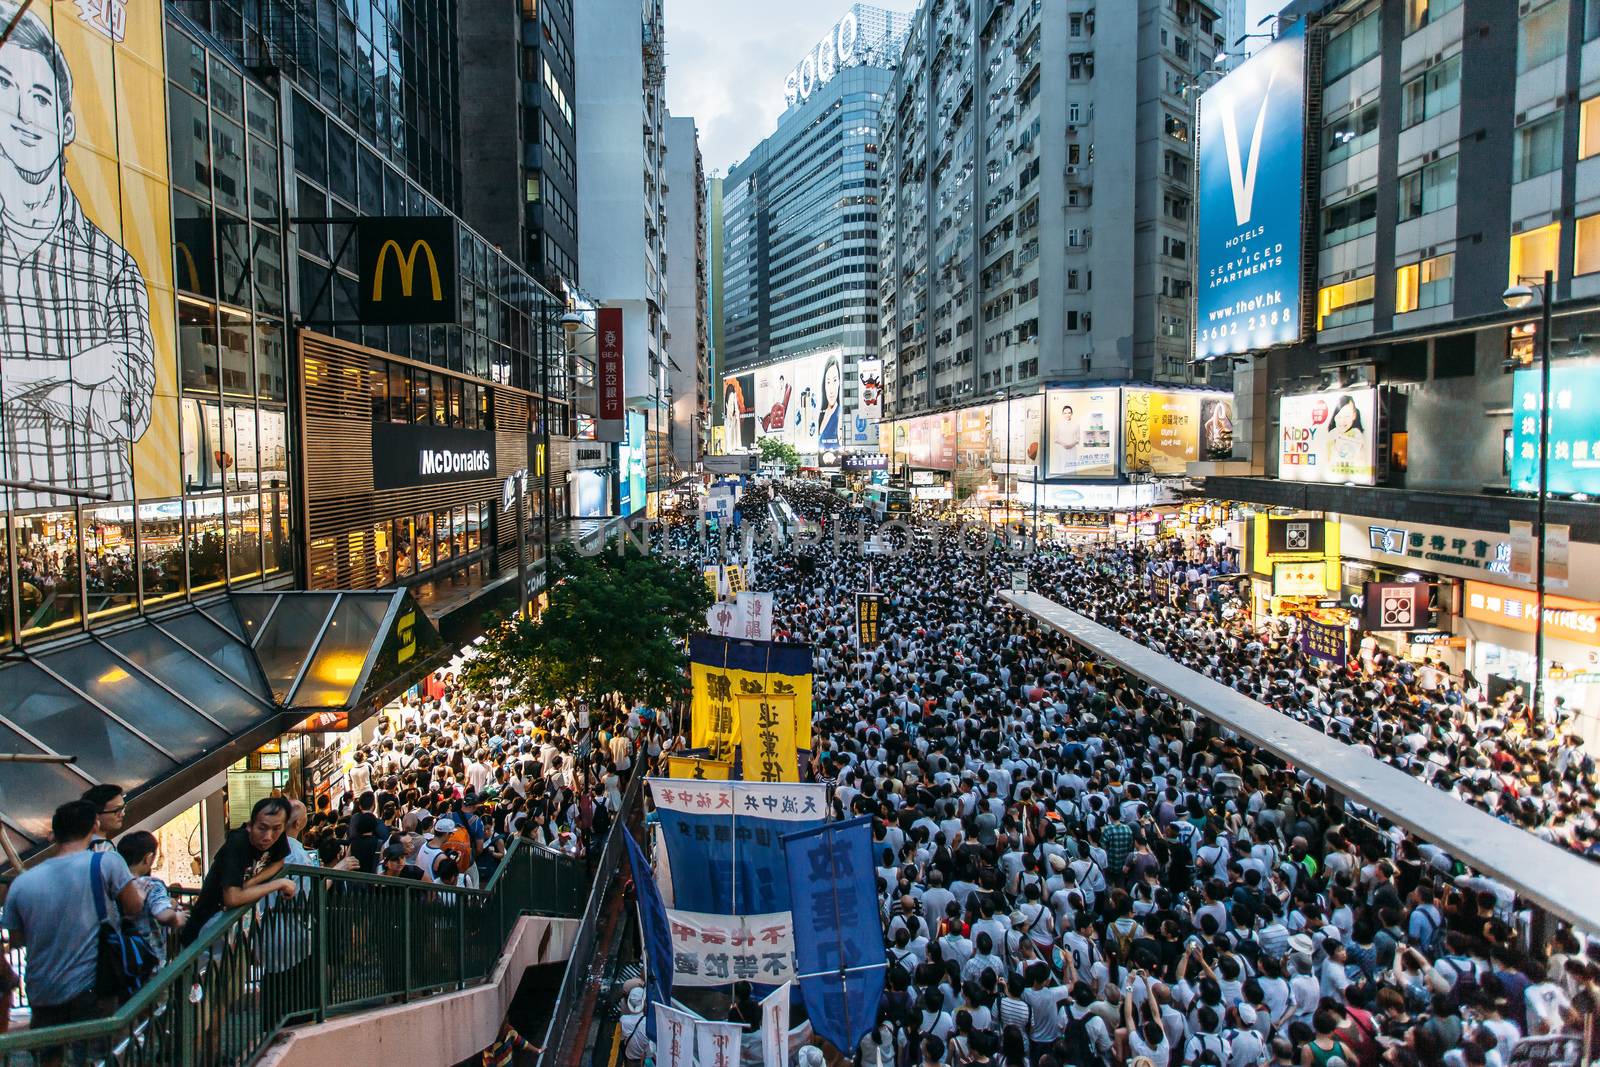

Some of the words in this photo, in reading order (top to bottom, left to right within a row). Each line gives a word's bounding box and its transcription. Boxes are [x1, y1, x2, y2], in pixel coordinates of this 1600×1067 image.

[1225, 225, 1264, 249] HOTELS
[1209, 256, 1282, 289] APARTMENTS
[1210, 243, 1283, 277] SERVICED
[1208, 291, 1281, 322] www.theV.hk
[1202, 322, 1238, 342] 3602
[1248, 308, 1291, 332] 2388
[606, 362, 617, 411] 東亞銀行
[421, 450, 490, 475] McDonald's
